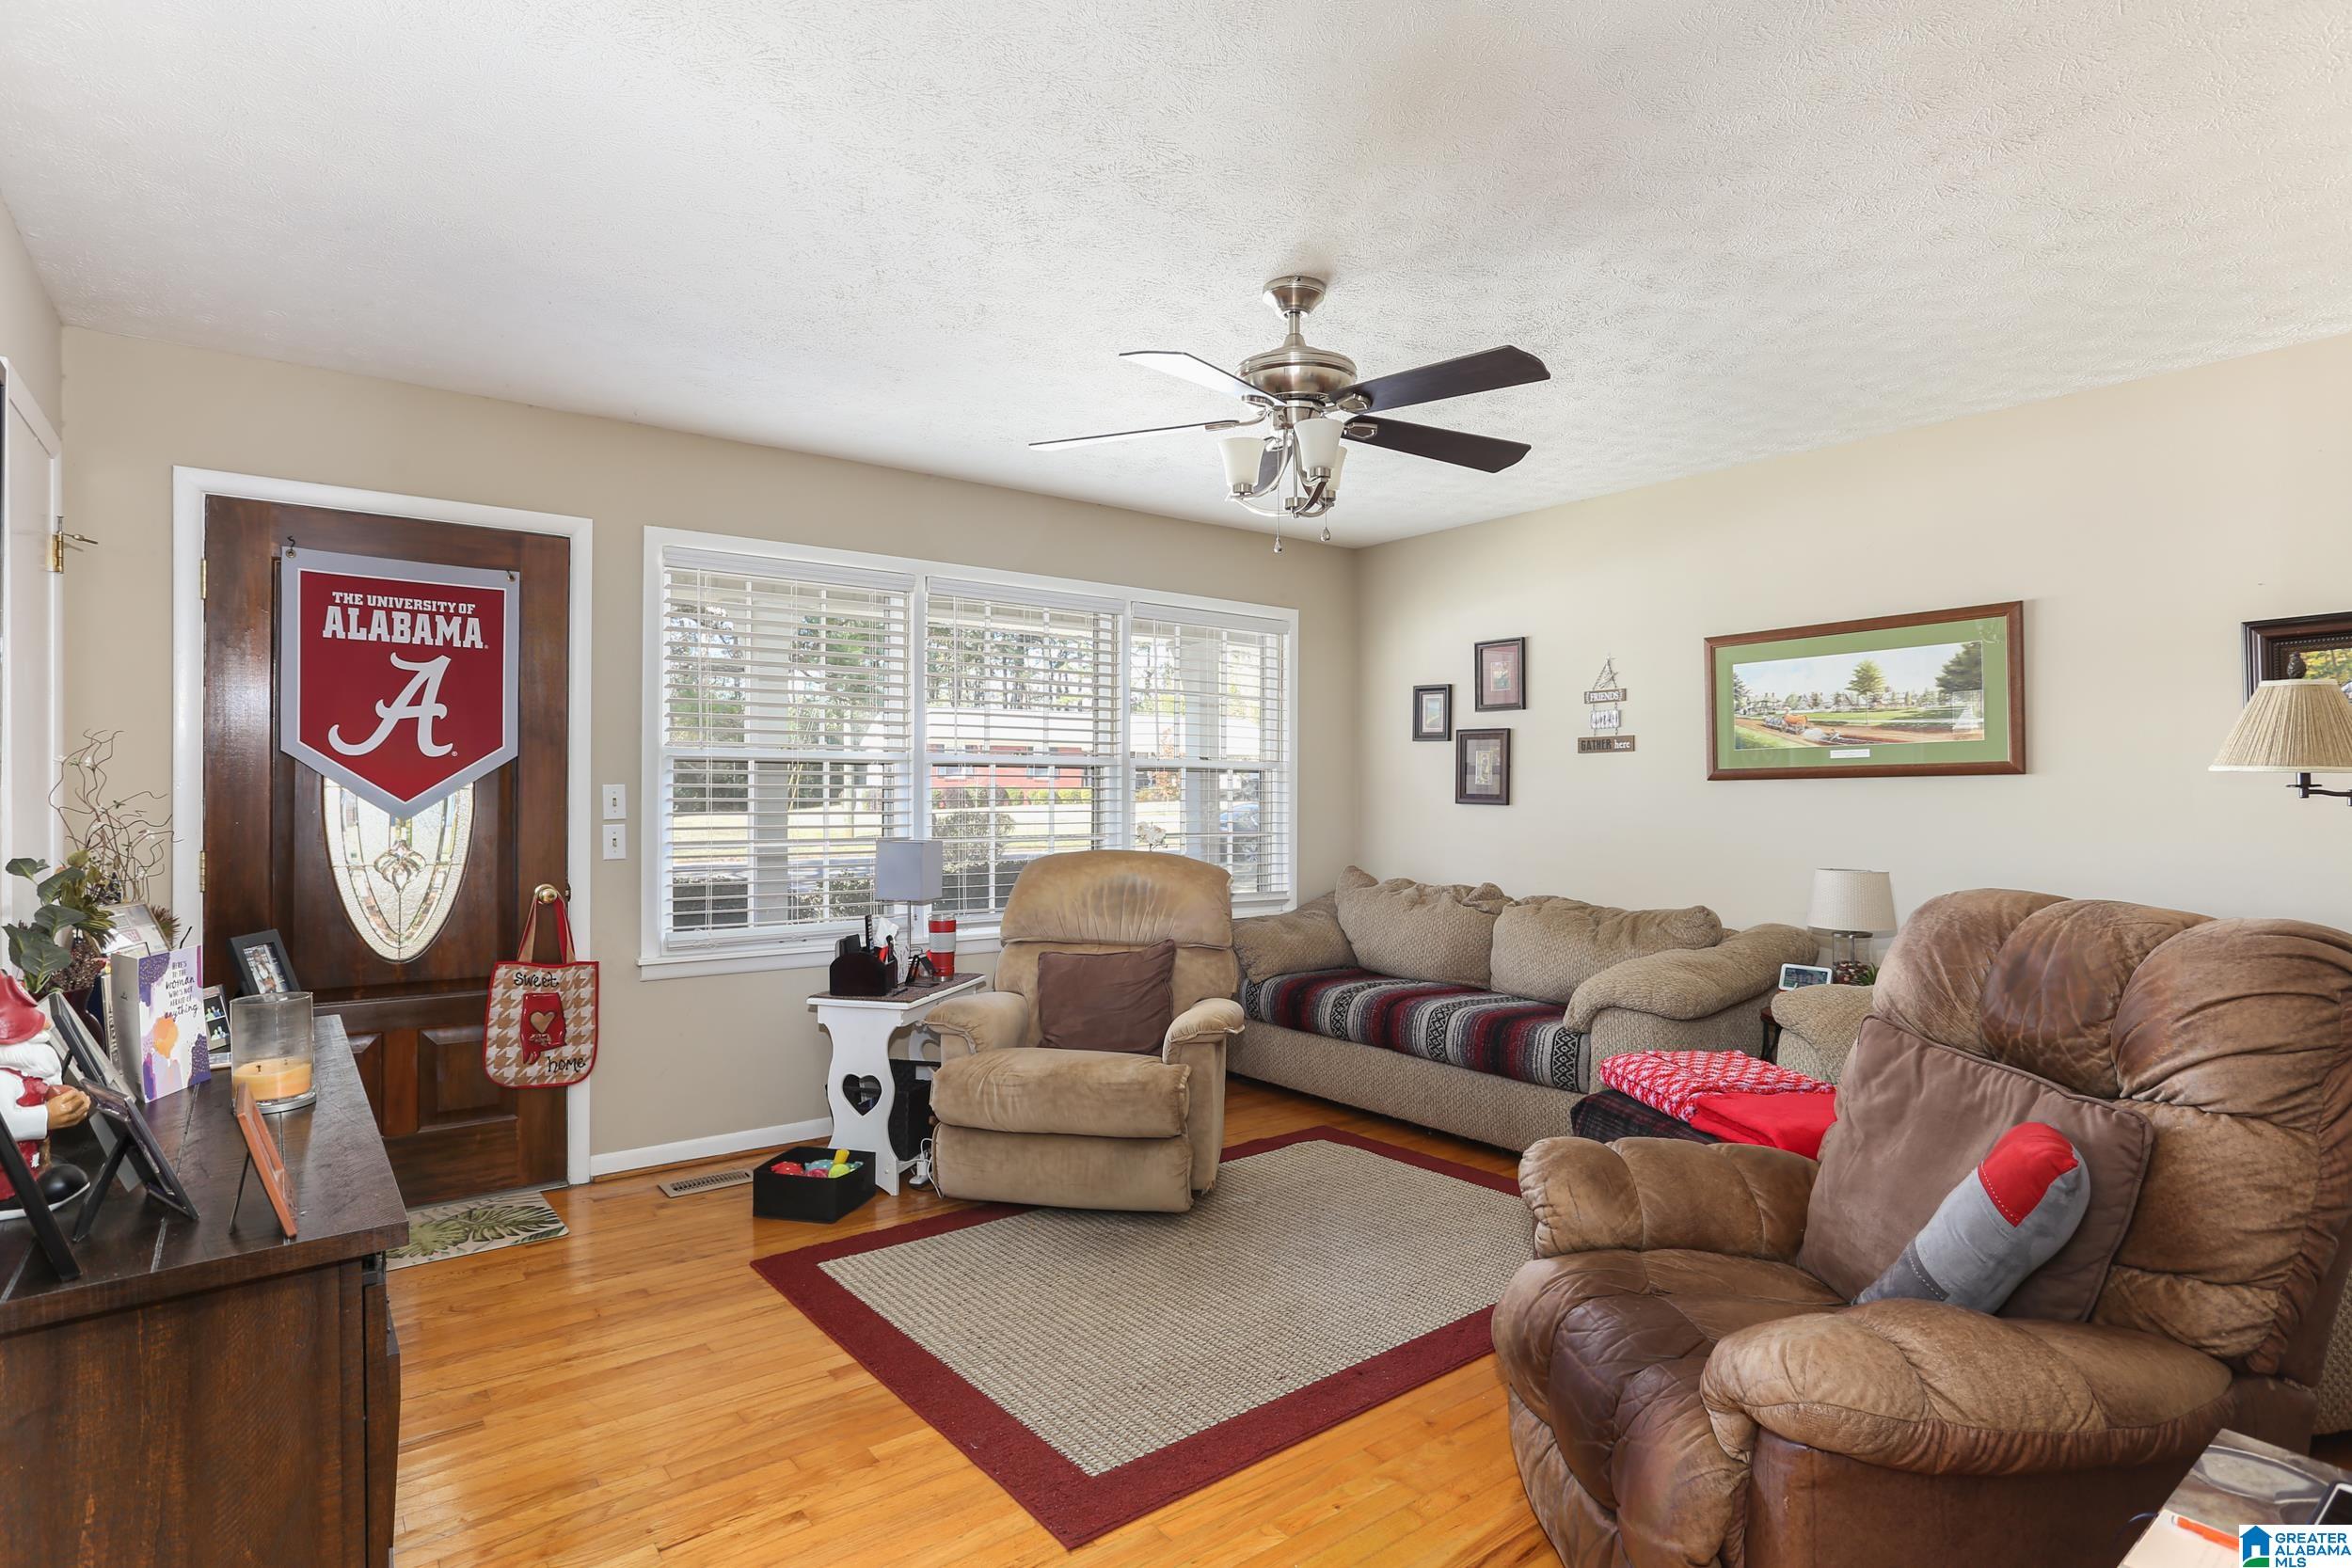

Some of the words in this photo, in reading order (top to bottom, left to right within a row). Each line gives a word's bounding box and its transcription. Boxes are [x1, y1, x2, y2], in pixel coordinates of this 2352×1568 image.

[332, 591, 363, 607] THE
[367, 594, 456, 614] UNIVERSITY
[458, 602, 476, 615] OF
[323, 605, 484, 649] ALABAMA
[328, 652, 453, 757] A
[1590, 690, 1618, 703] FRIENDS
[1581, 738, 1612, 752] GATHER
[1613, 739, 1631, 750] here
[165, 1004, 199, 1022] anything
